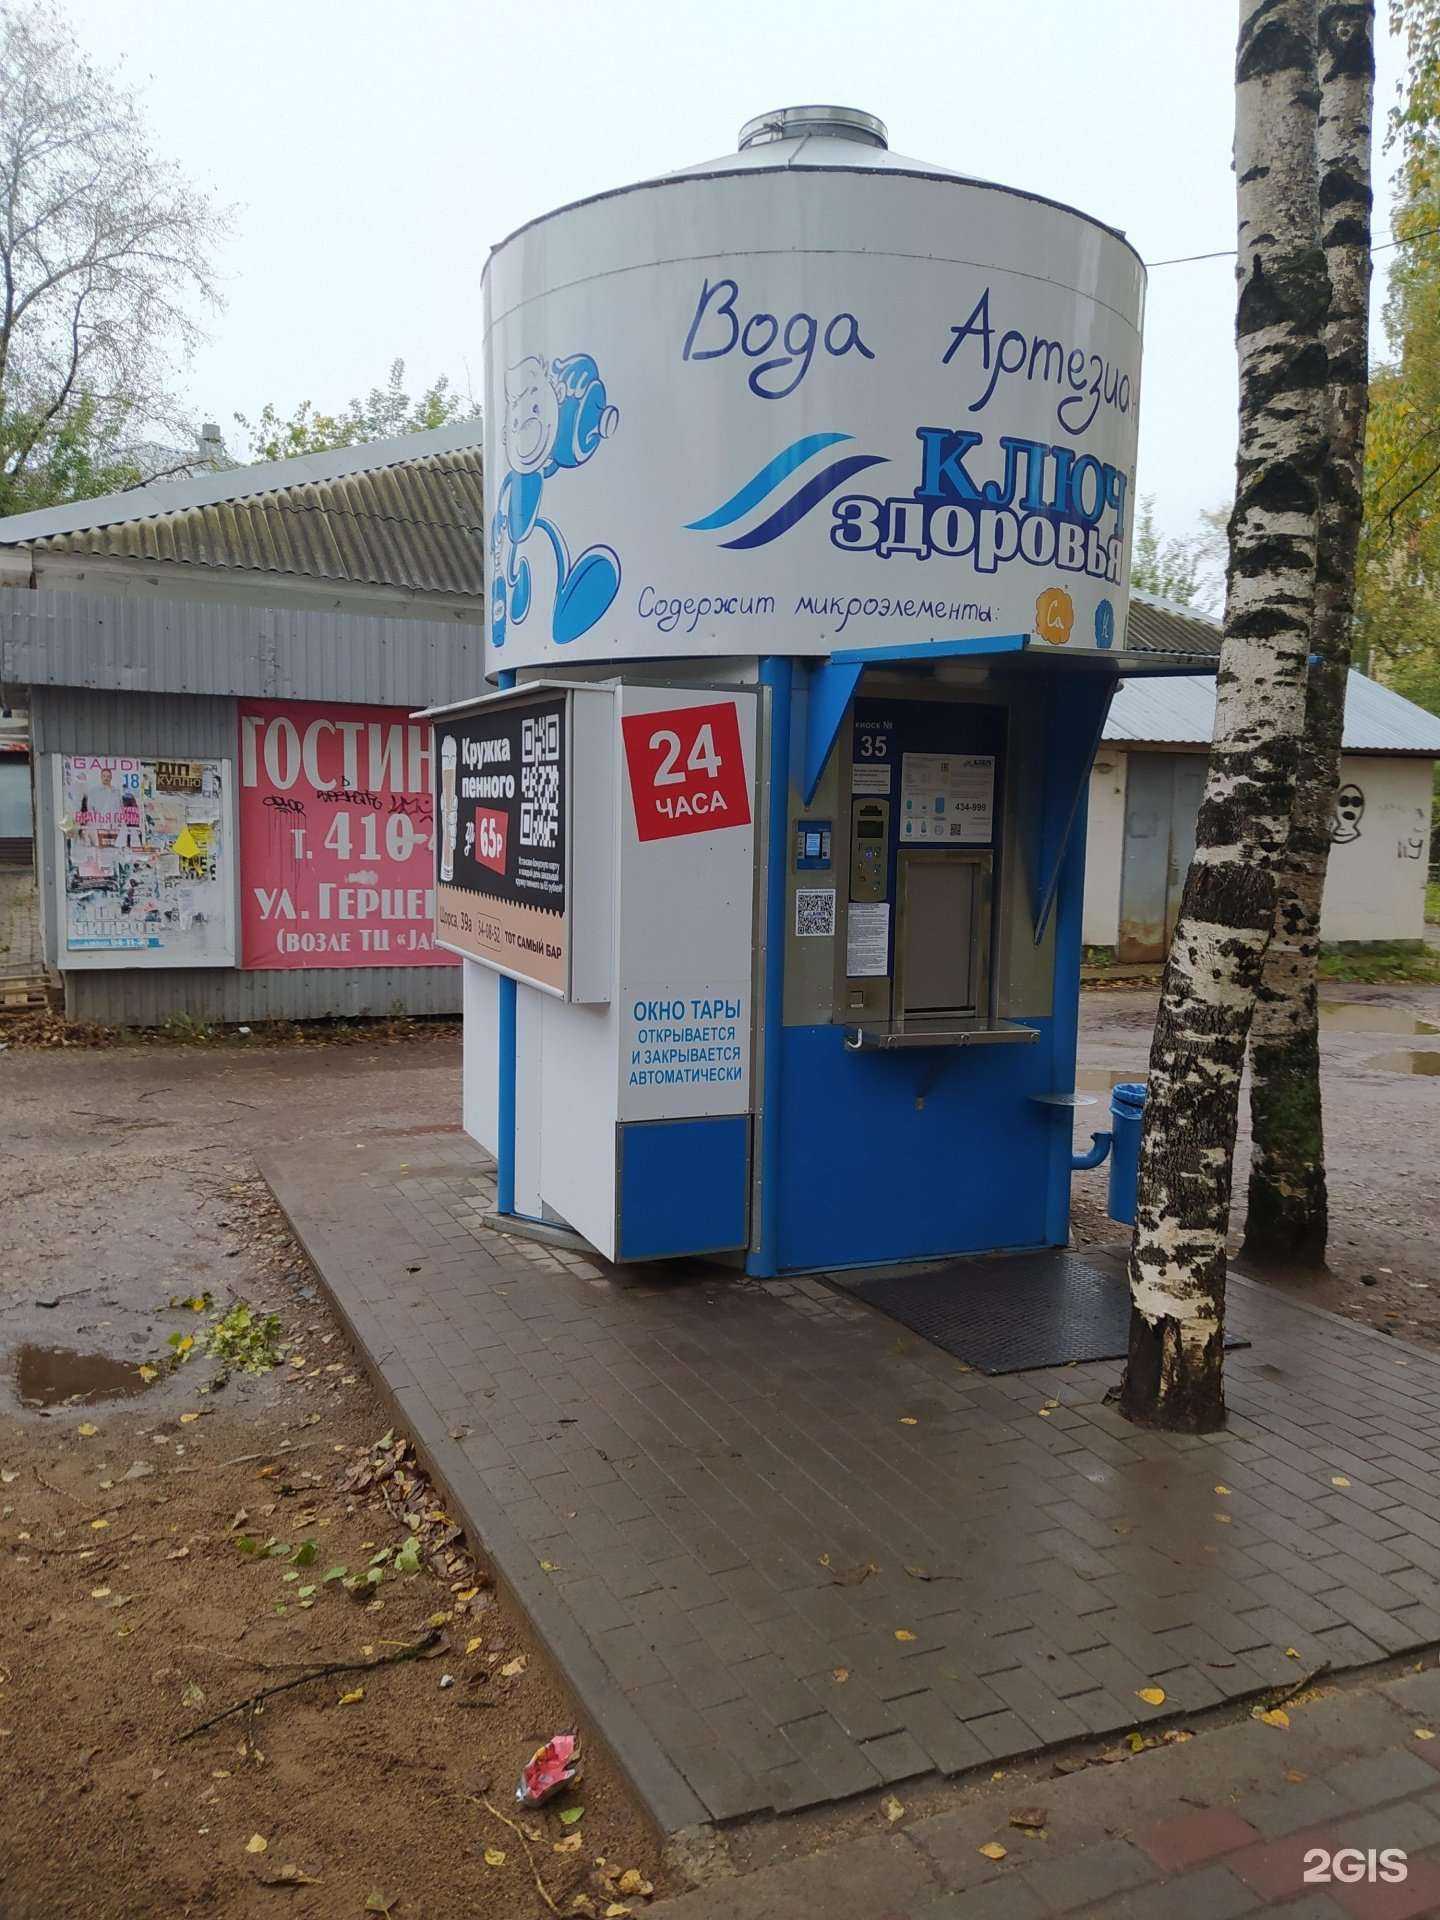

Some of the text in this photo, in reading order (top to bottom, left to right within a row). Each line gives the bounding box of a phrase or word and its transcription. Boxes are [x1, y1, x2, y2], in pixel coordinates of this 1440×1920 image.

[681, 277, 875, 400] Вода
[830, 494, 1122, 586] здоровья
[638, 585, 776, 633] Содержит
[461, 737, 511, 771] Кружка
[648, 723, 722, 787] 24
[860, 735, 887, 757] 35
[73, 757, 140, 771] GAUDI
[122, 773, 140, 790] 18
[461, 774, 516, 799] пенного
[655, 790, 728, 819] ЧАСА
[359, 929, 389, 951] ТЦ
[504, 930, 516, 945] ТОТ
[517, 935, 544, 956] САМЫЙ
[545, 943, 562, 960] БАР
[633, 999, 741, 1021] ОКНО ТАРЫ
[638, 1026, 736, 1044] ОТКРЫВАЕТСЯ
[631, 1046, 741, 1065] И ЗАКРЫВАЕТСЯ
[629, 1066, 742, 1087] АВТОМАТИЧЕСКИ
